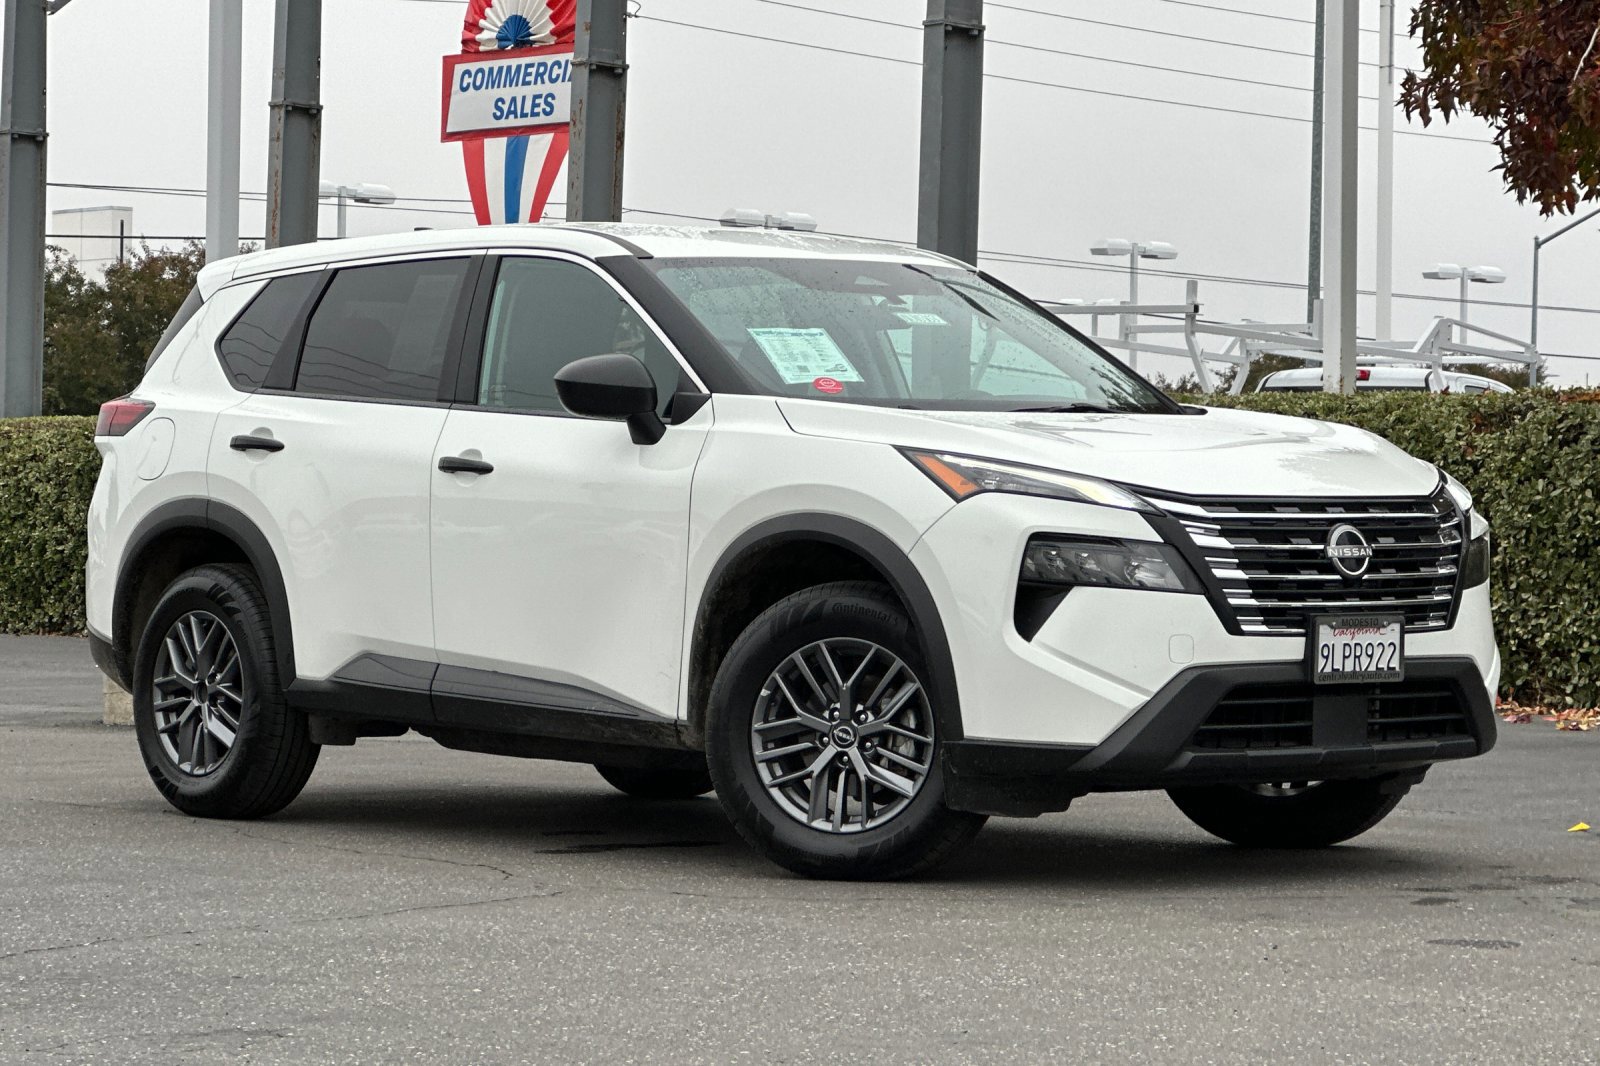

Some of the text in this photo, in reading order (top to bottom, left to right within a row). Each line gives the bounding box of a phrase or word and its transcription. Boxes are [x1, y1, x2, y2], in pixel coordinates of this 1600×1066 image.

[492, 92, 556, 121] SALES
[1329, 547, 1373, 557] NISSAN
[832, 602, 891, 624] Continental
[1341, 618, 1379, 627] MODESTO
[1321, 642, 1397, 673] 9LPR922
